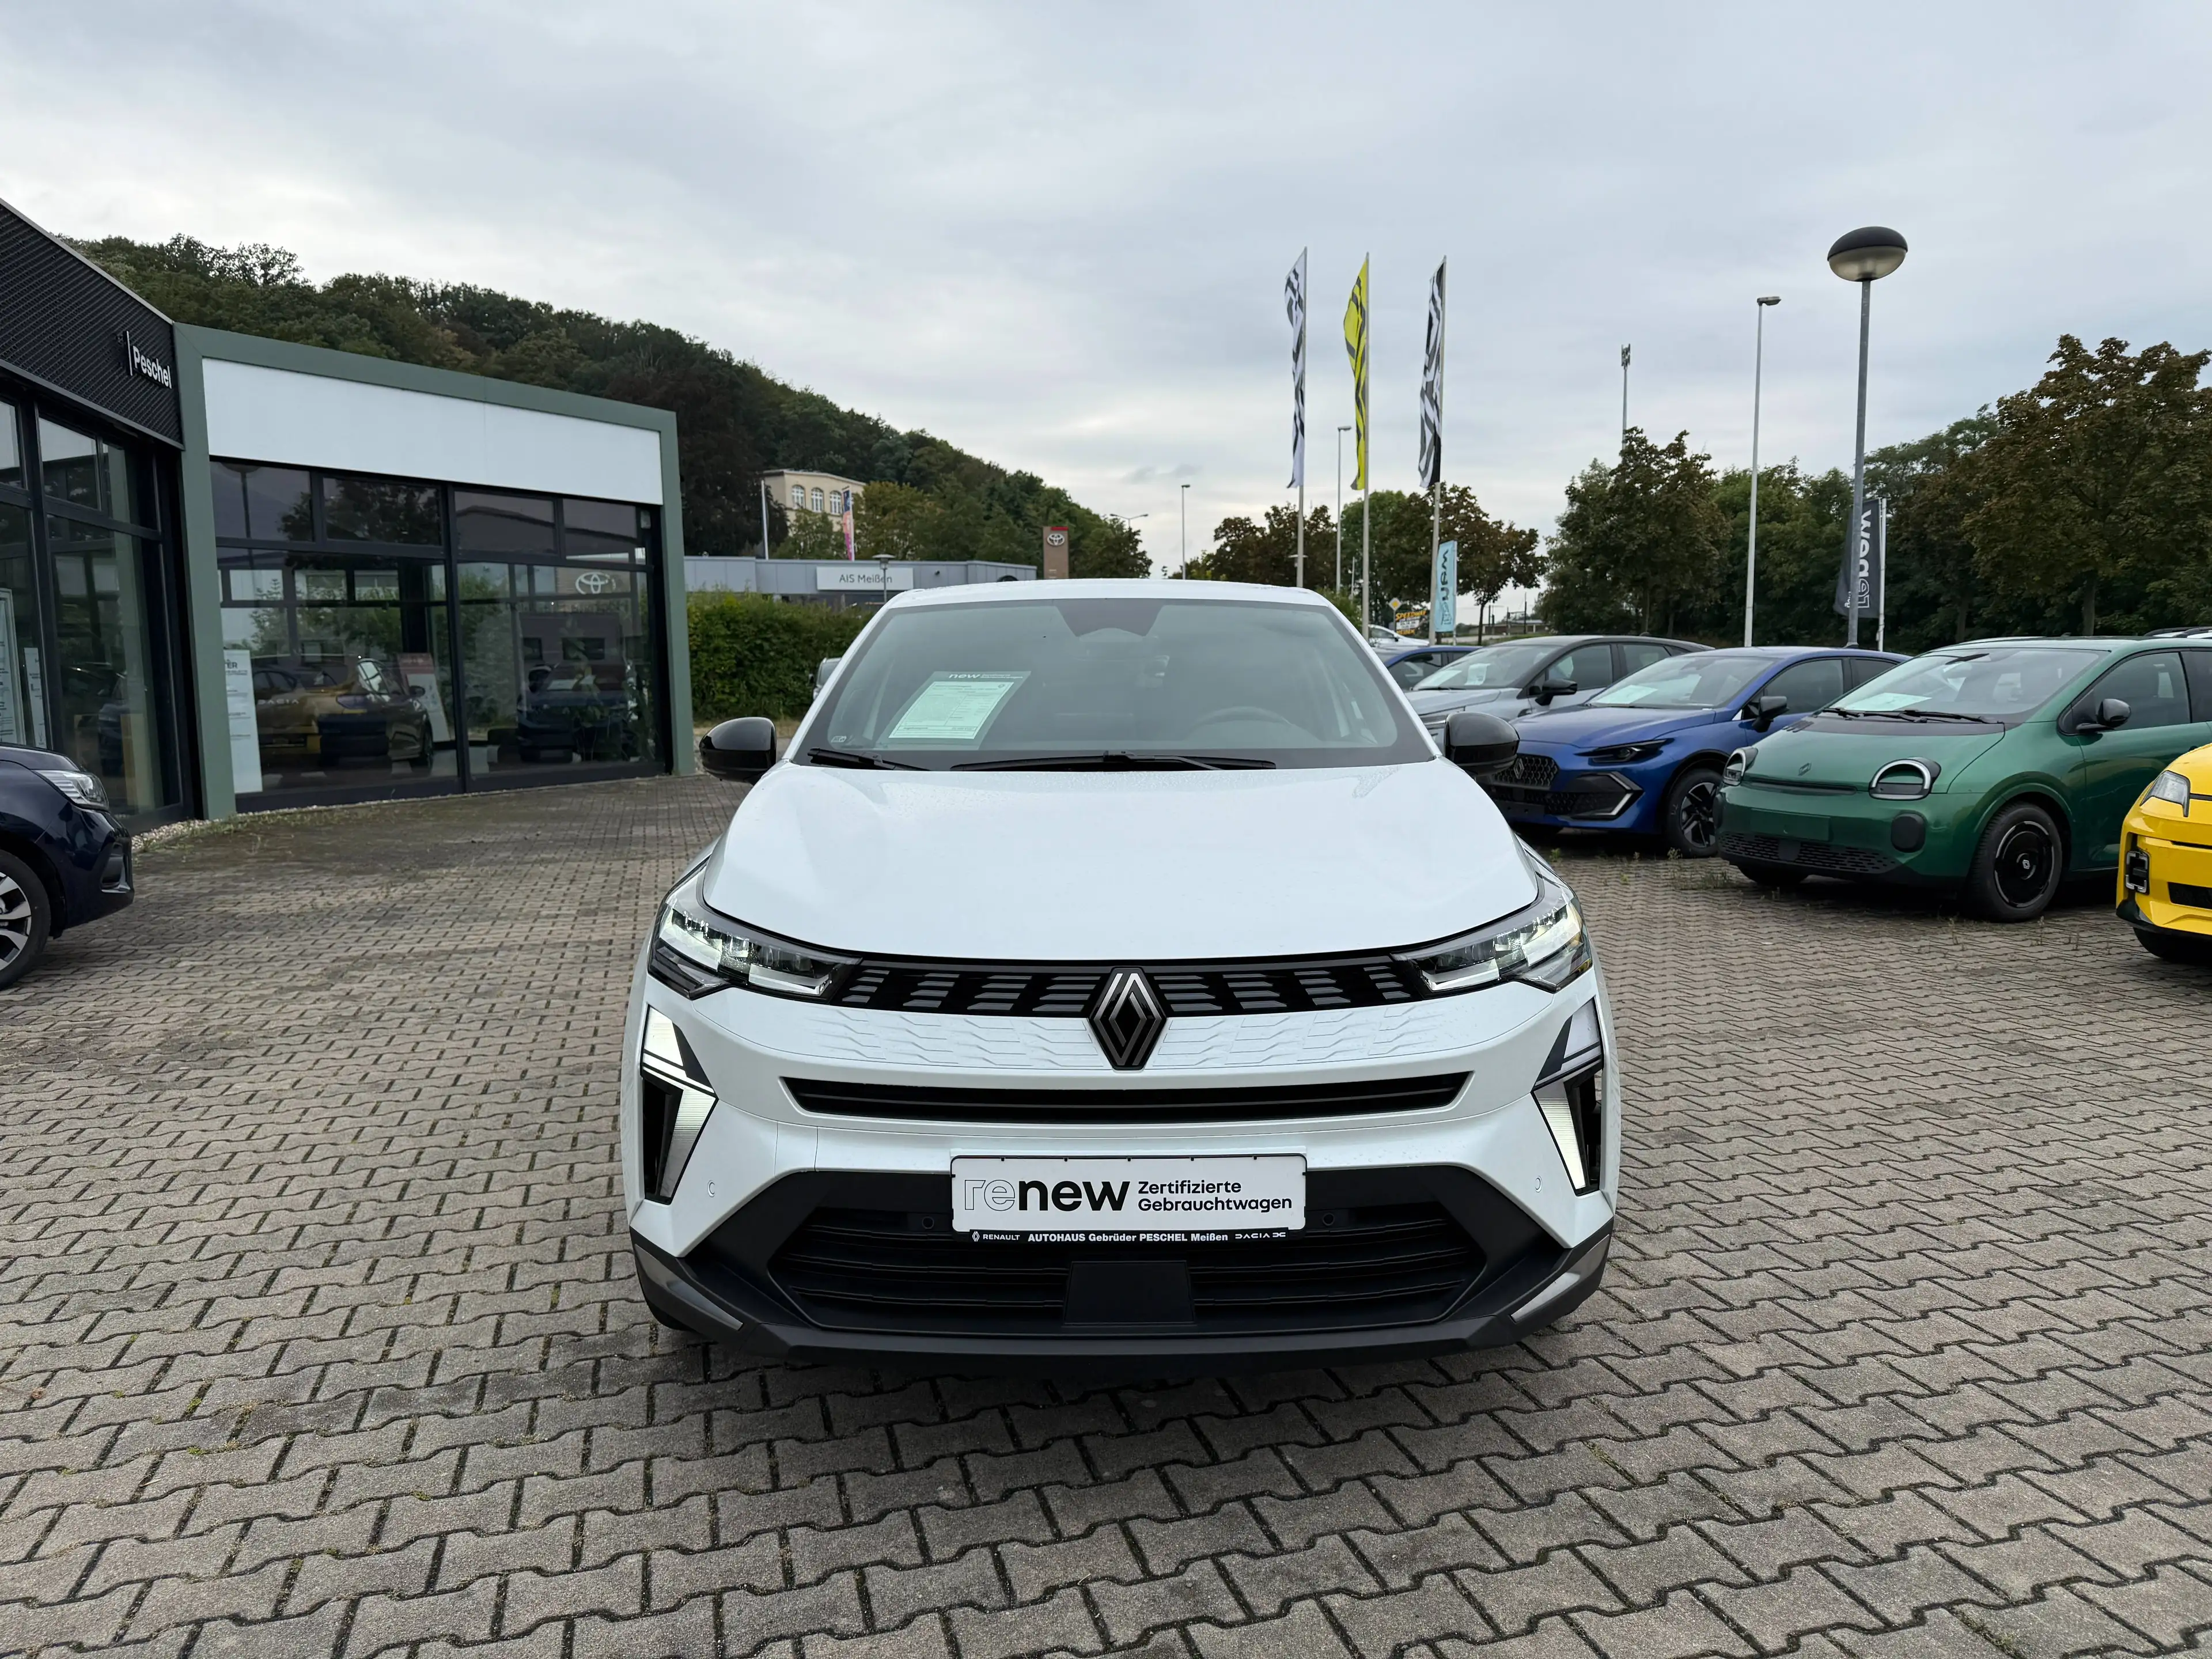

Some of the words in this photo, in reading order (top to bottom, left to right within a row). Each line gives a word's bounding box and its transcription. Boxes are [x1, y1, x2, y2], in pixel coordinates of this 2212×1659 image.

[132, 345, 172, 389] Peschel
[839, 574, 855, 583] AIS
[964, 1179, 1131, 1212] renew
[1138, 1179, 1242, 1194] Zertifizierte
[1138, 1196, 1293, 1213] Gebrauchtwagen
[1028, 1233, 1086, 1242] AUTOHAUS
[1088, 1233, 1137, 1242] Gebrüder
[1139, 1233, 1188, 1242] PESCHEL
[1191, 1232, 1229, 1241] Meißen
